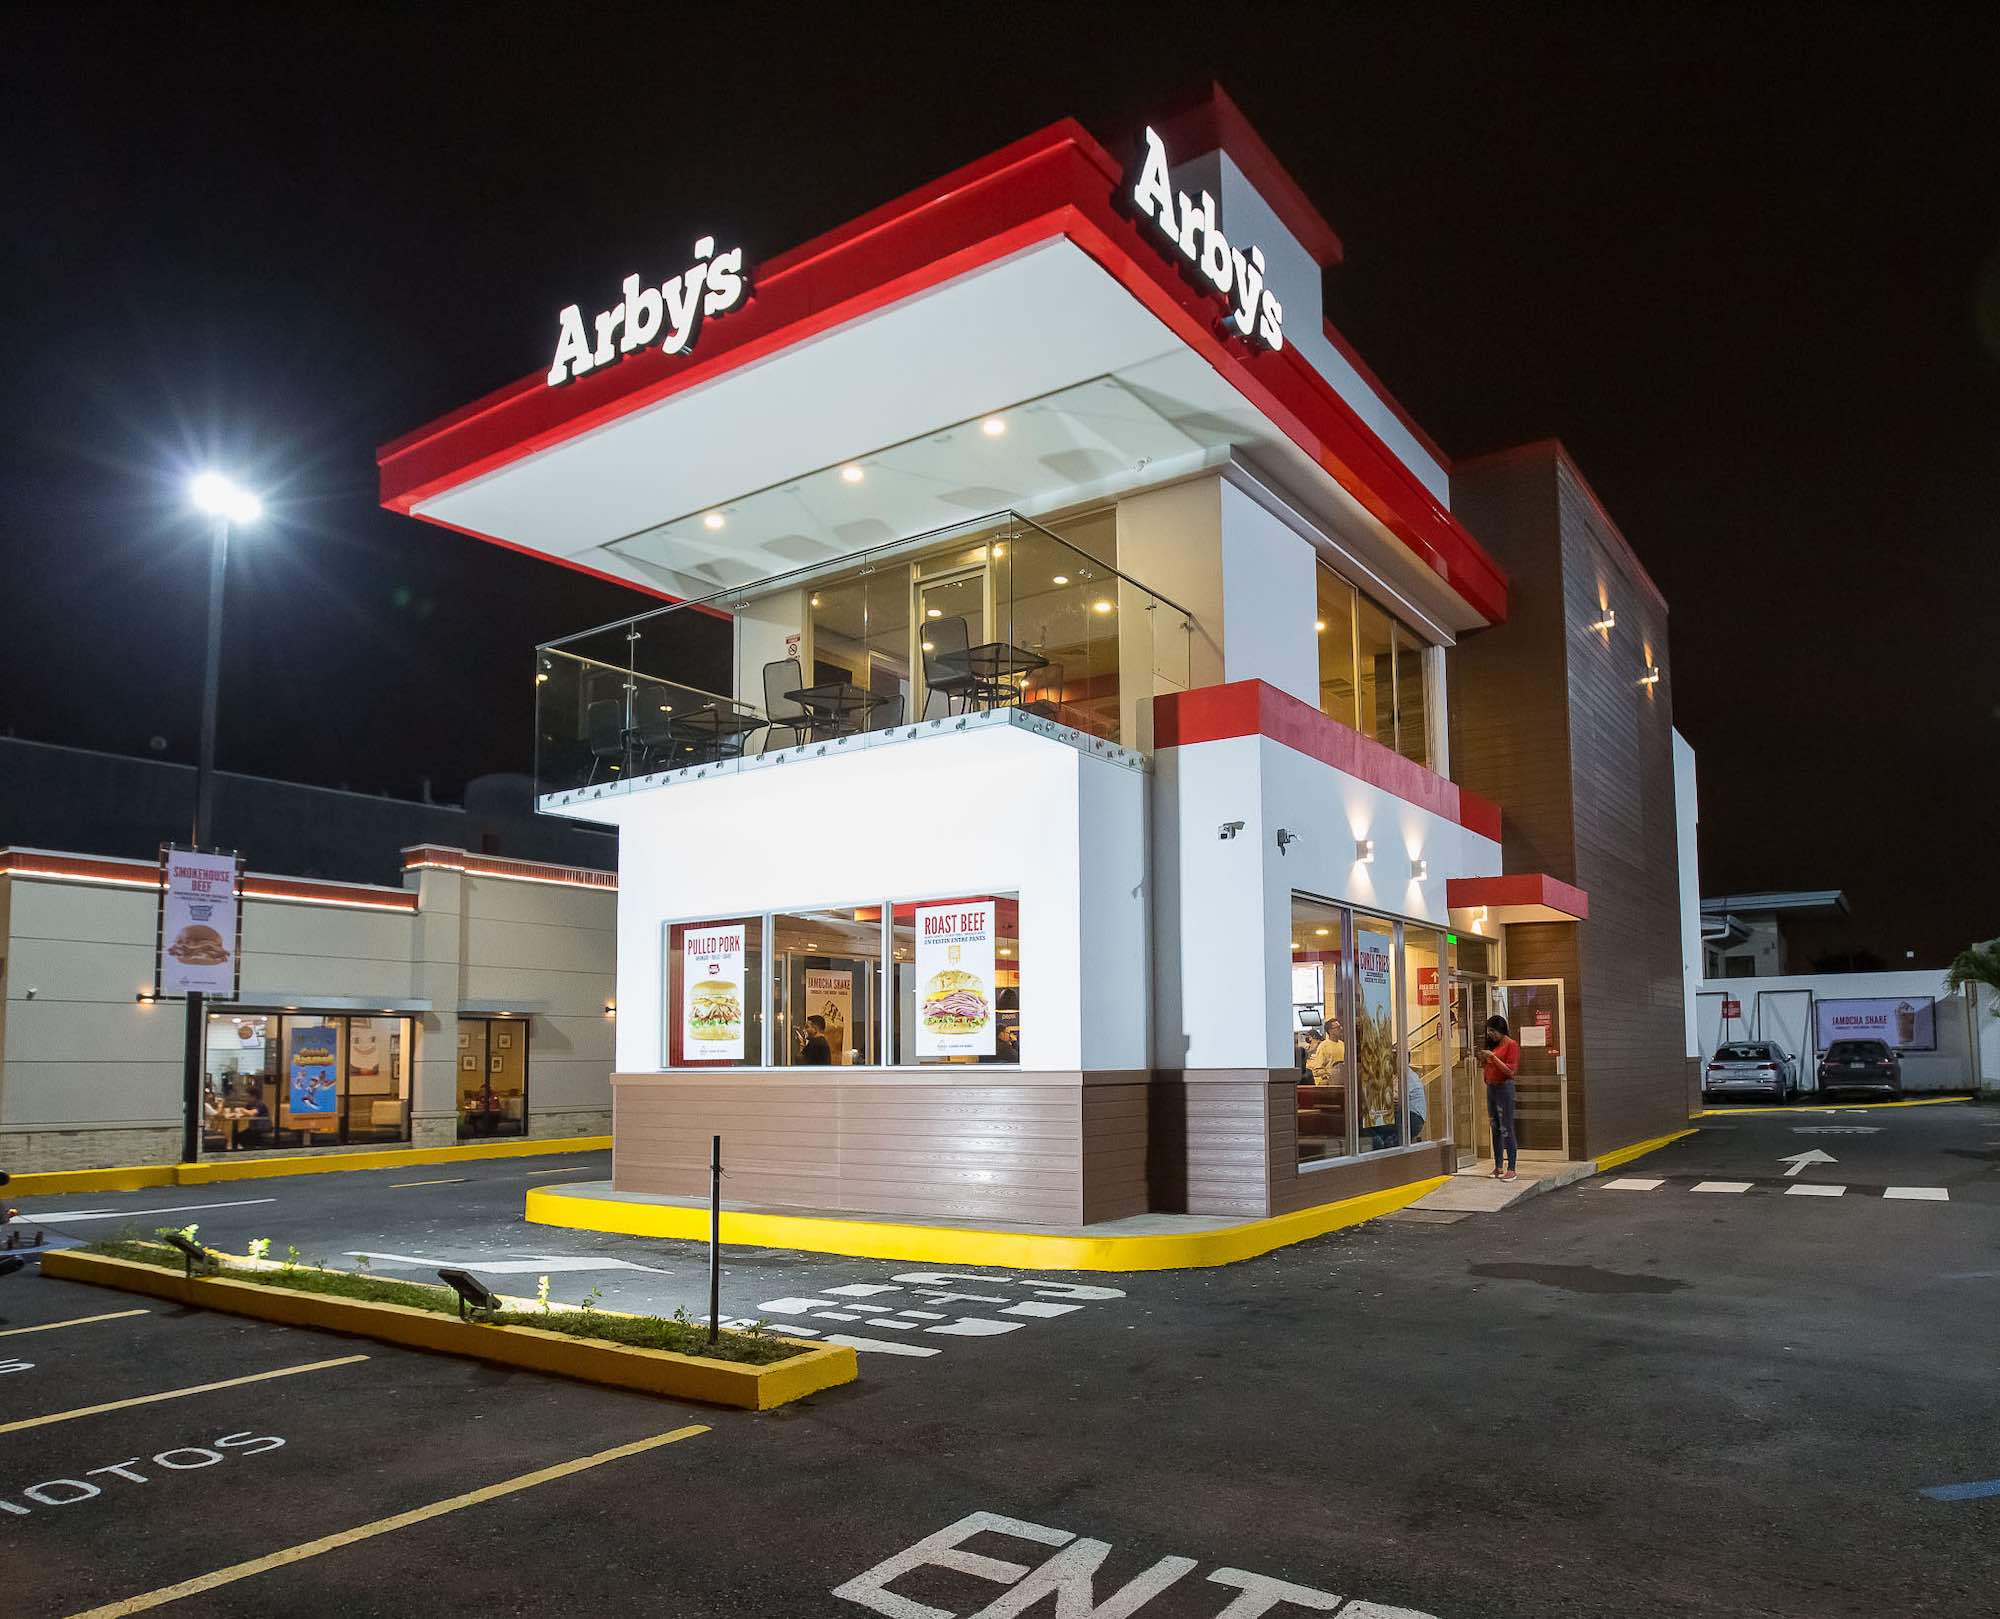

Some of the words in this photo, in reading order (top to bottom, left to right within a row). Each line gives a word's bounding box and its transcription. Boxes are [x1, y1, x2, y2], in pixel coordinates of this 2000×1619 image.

[1134, 125, 1283, 351] Arby's
[547, 235, 742, 387] Arby's
[174, 865, 230, 882] SMOKEHOUSE
[191, 880, 212, 892] BEEF
[924, 914, 957, 935] ROAST
[961, 912, 985, 932] BEEF
[688, 937, 717, 955] PULLED
[719, 935, 740, 952] PORK
[0, 1432, 286, 1515] OTOS
